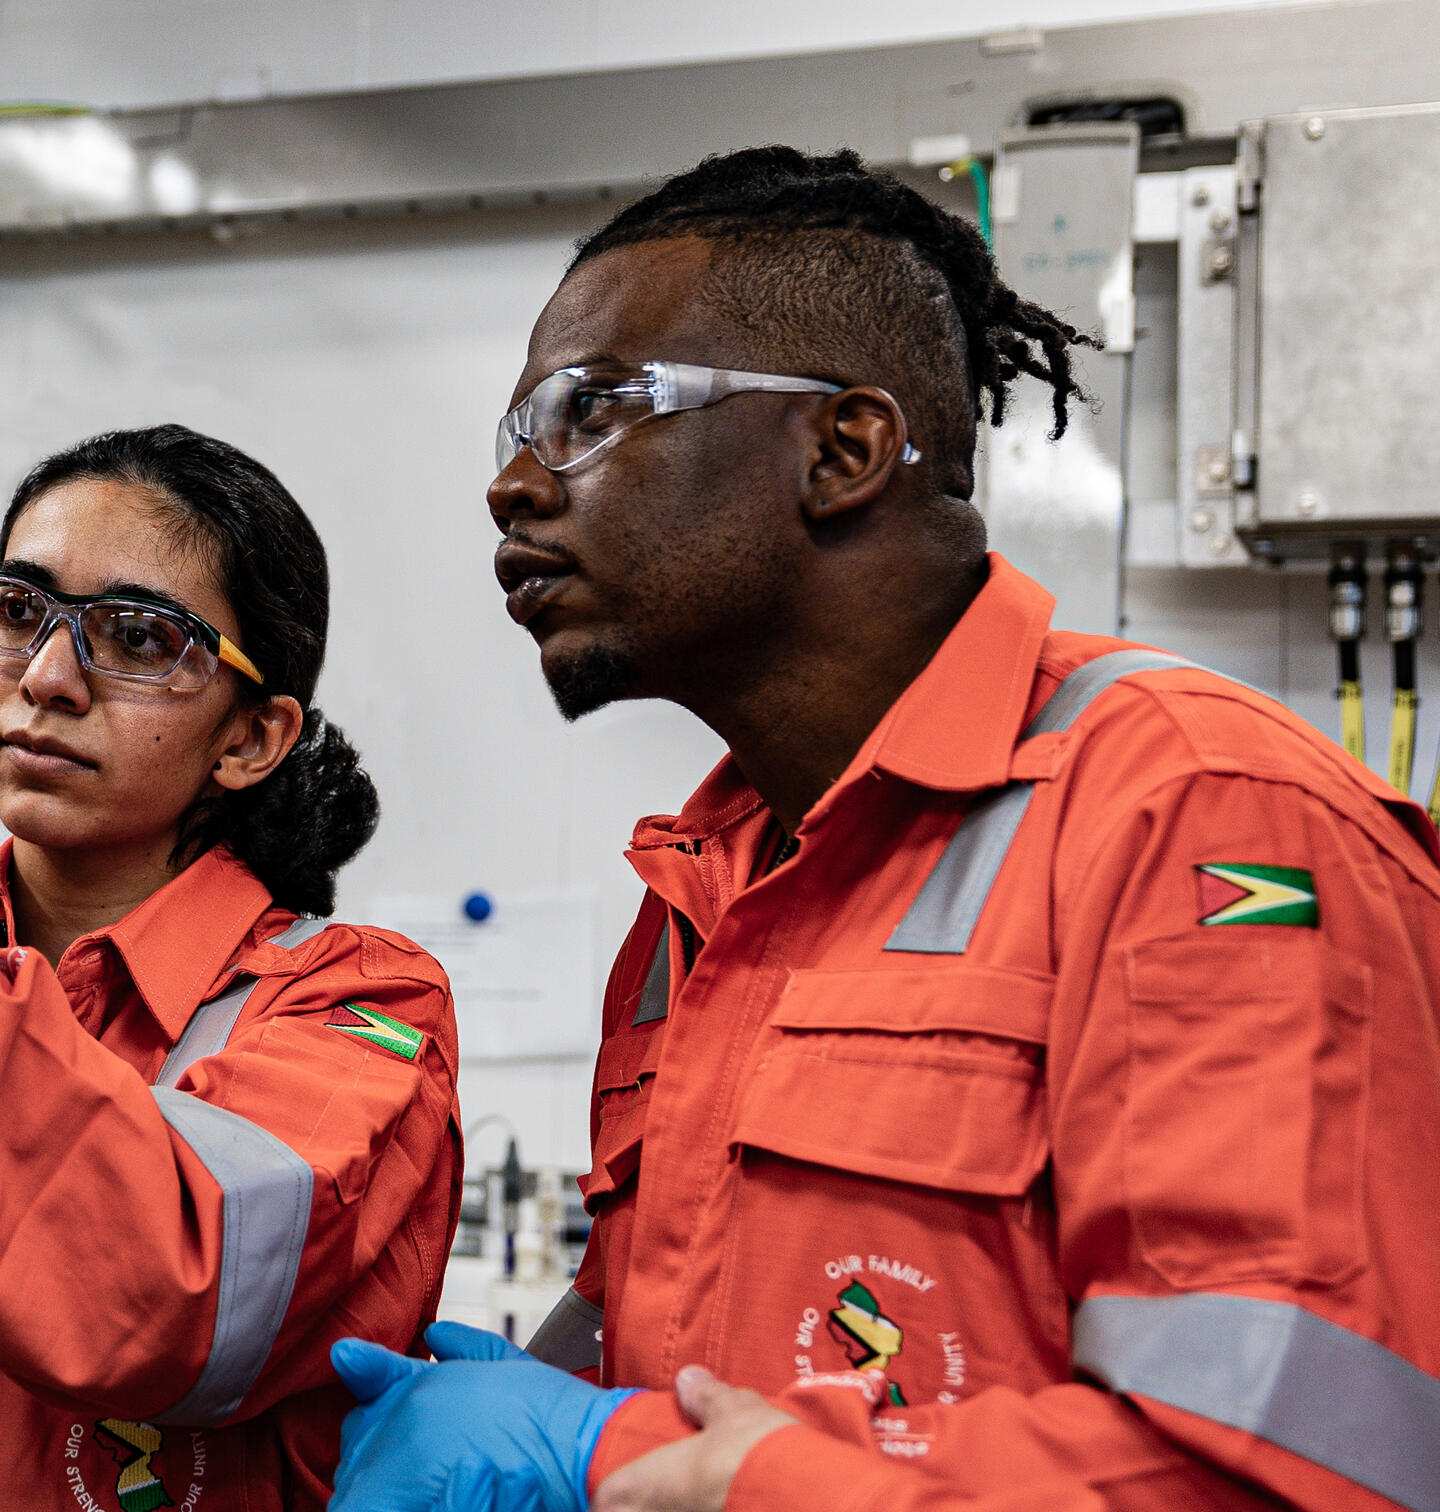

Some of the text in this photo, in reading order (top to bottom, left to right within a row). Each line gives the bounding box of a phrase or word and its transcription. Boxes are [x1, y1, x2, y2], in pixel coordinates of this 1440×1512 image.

[825, 1255, 937, 1292] OUR FAMILY
[795, 1307, 820, 1348] OUR
[937, 1331, 964, 1387] UNITY
[64, 1423, 84, 1459] OUR
[180, 1431, 208, 1512] OUR UNITY
